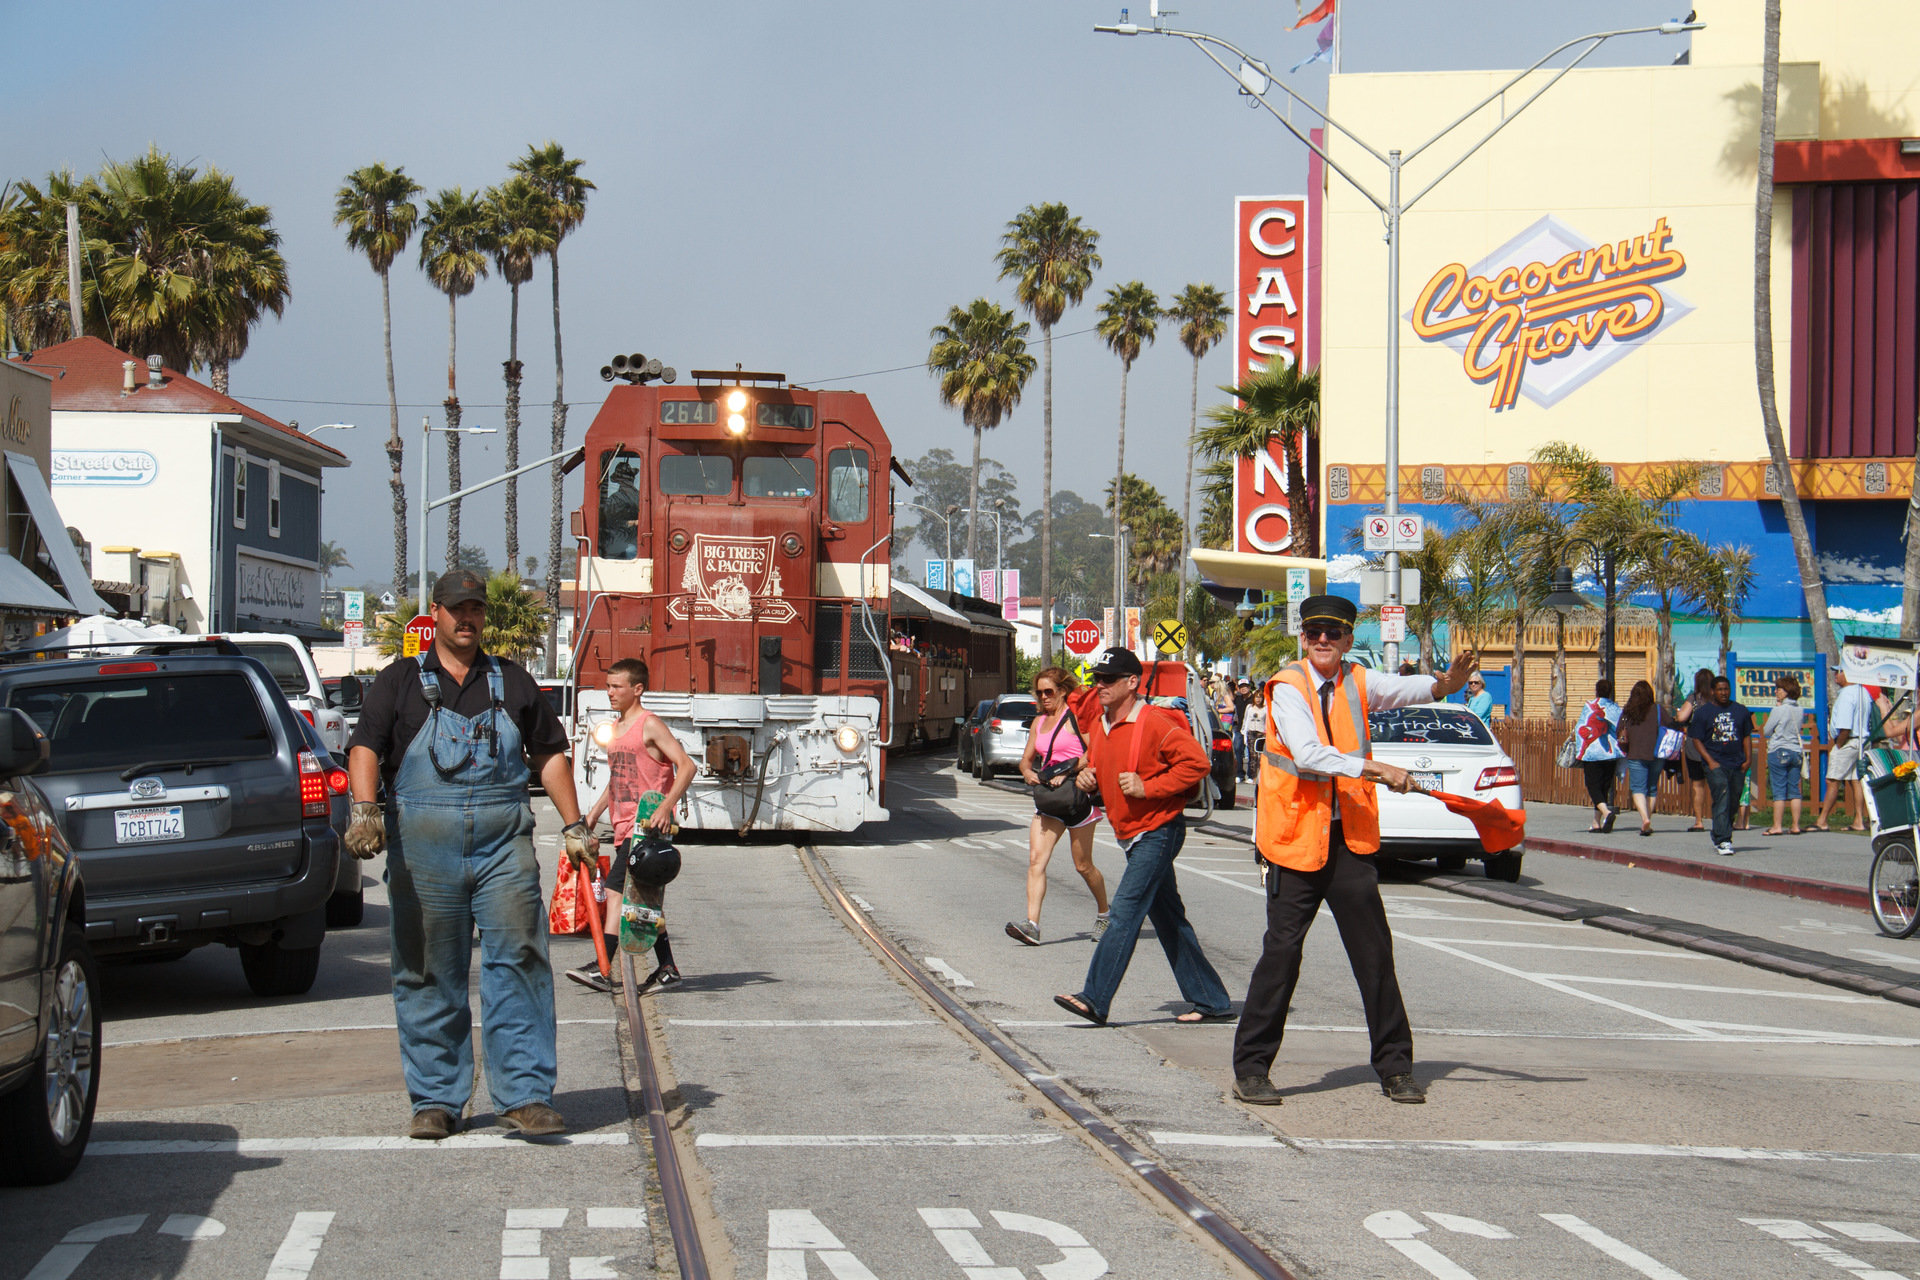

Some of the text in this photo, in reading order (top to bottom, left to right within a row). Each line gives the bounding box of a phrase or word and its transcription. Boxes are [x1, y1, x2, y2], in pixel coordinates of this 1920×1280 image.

[1411, 216, 1686, 340] Cocoanut
[1463, 284, 1663, 408] Grove
[1245, 207, 1297, 553] CASNO
[664, 402, 713, 423] 2641
[759, 405, 809, 428] 2641
[54, 455, 153, 471] Street Cafe
[51, 473, 81, 481] Corner
[703, 545, 766, 560] BIG TREES
[705, 558, 763, 574] & PACIFIC
[1067, 630, 1098, 644] STOP
[1155, 632, 1186, 641] R R
[120, 818, 181, 838] 7CBT742
[247, 840, 295, 851] 4RUNNER
